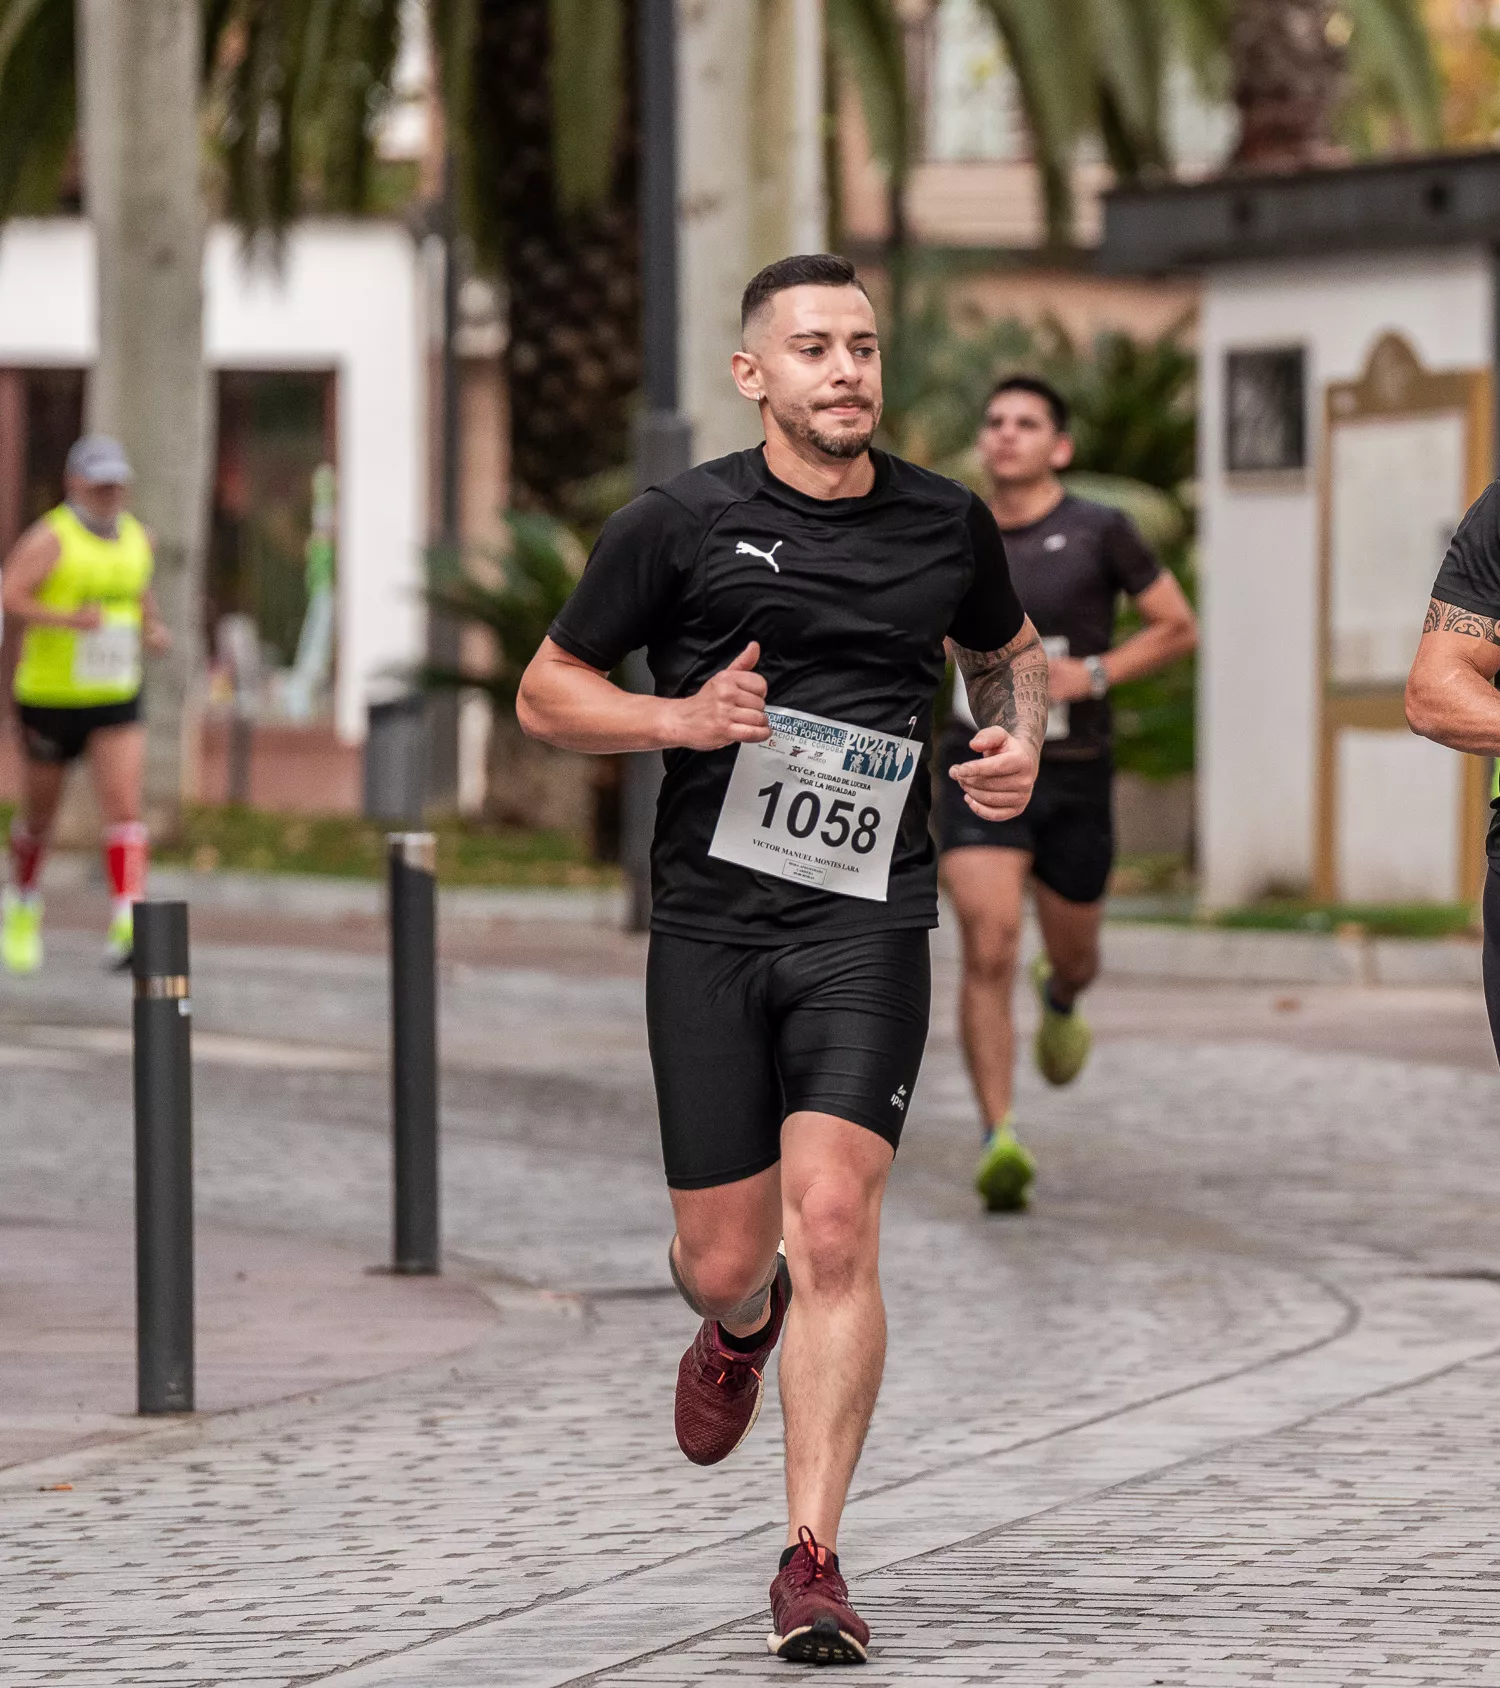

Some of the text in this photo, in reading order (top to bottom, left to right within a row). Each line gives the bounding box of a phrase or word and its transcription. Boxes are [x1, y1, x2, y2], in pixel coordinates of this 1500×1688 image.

[768, 722, 846, 748] RERAS POPULARES
[793, 717, 835, 736] PROVINCIAL
[838, 730, 848, 739] DE
[847, 731, 887, 754] 2024
[799, 777, 857, 797] POR LA IGUALDAD
[817, 772, 841, 785] CIUDAD
[841, 778, 850, 786] DE
[850, 779, 871, 791] LUCENA
[757, 780, 881, 854] 1058
[752, 839, 860, 874] VICTOR MANUEL MONTES LARA
